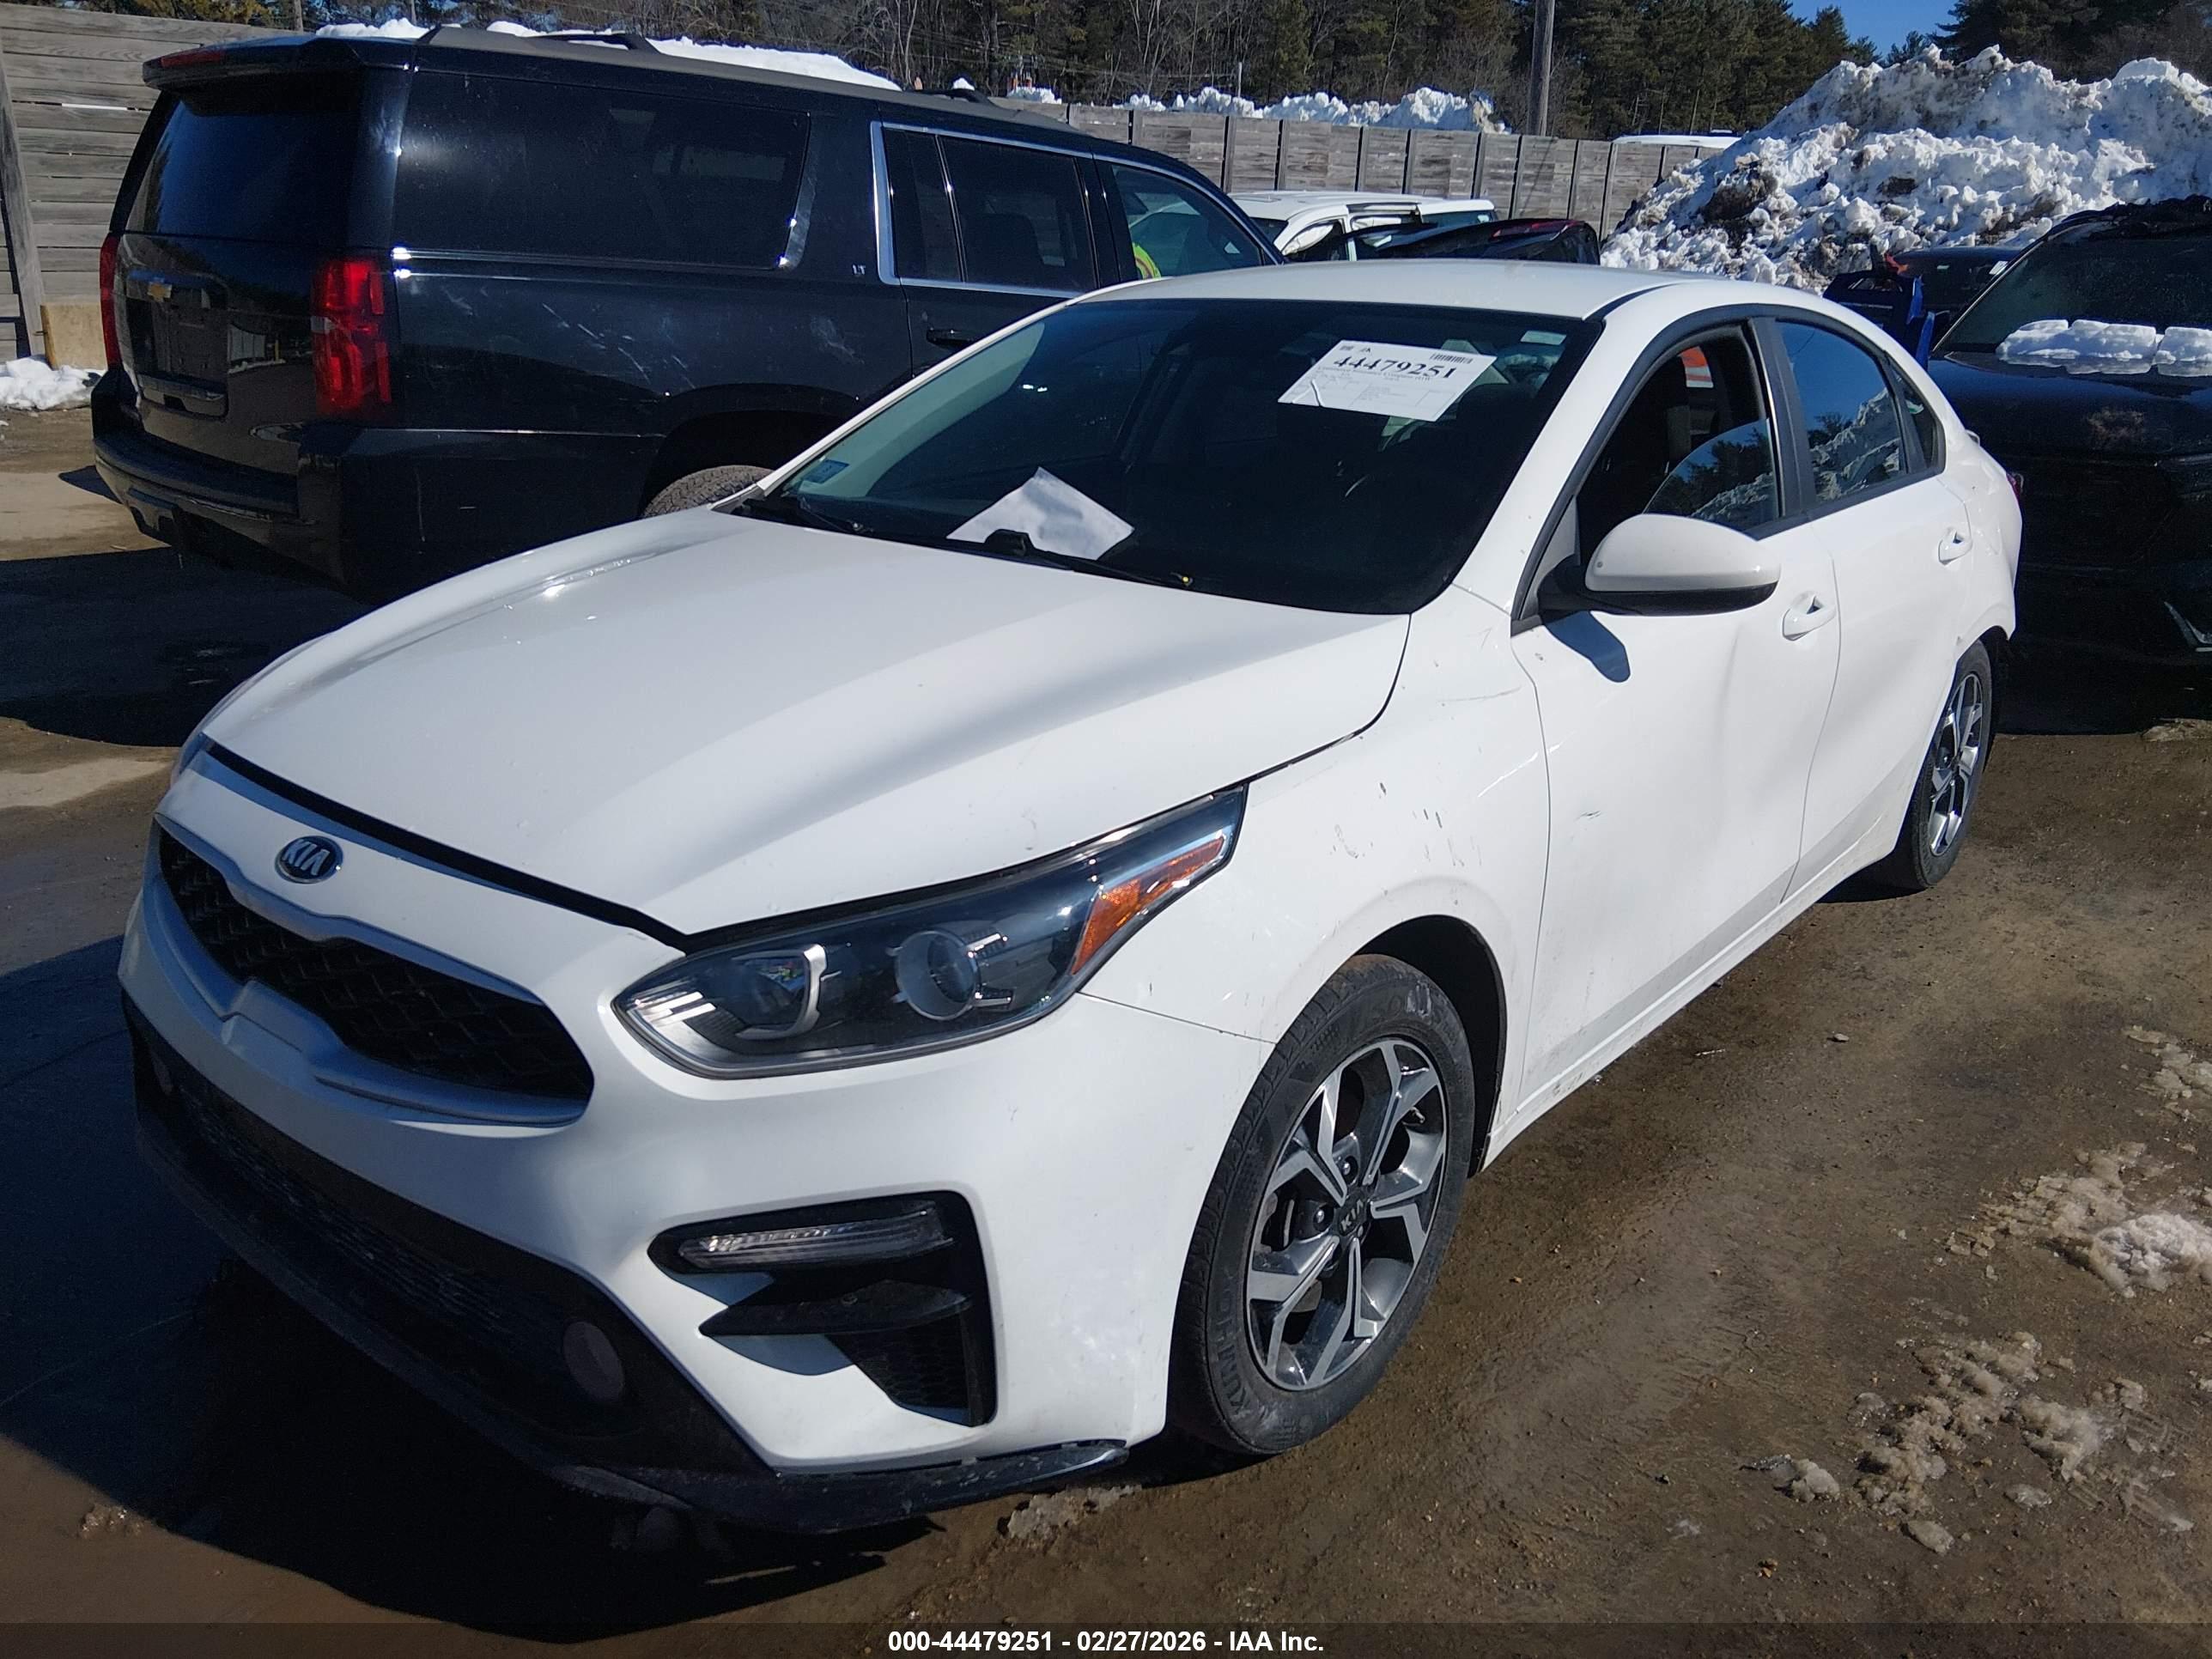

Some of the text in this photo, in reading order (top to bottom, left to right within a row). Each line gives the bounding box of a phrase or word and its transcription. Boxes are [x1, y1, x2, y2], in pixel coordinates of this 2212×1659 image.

[1334, 355, 1457, 379] 44479251
[282, 838, 331, 876] KIA
[1340, 1198, 1364, 1232] KIA
